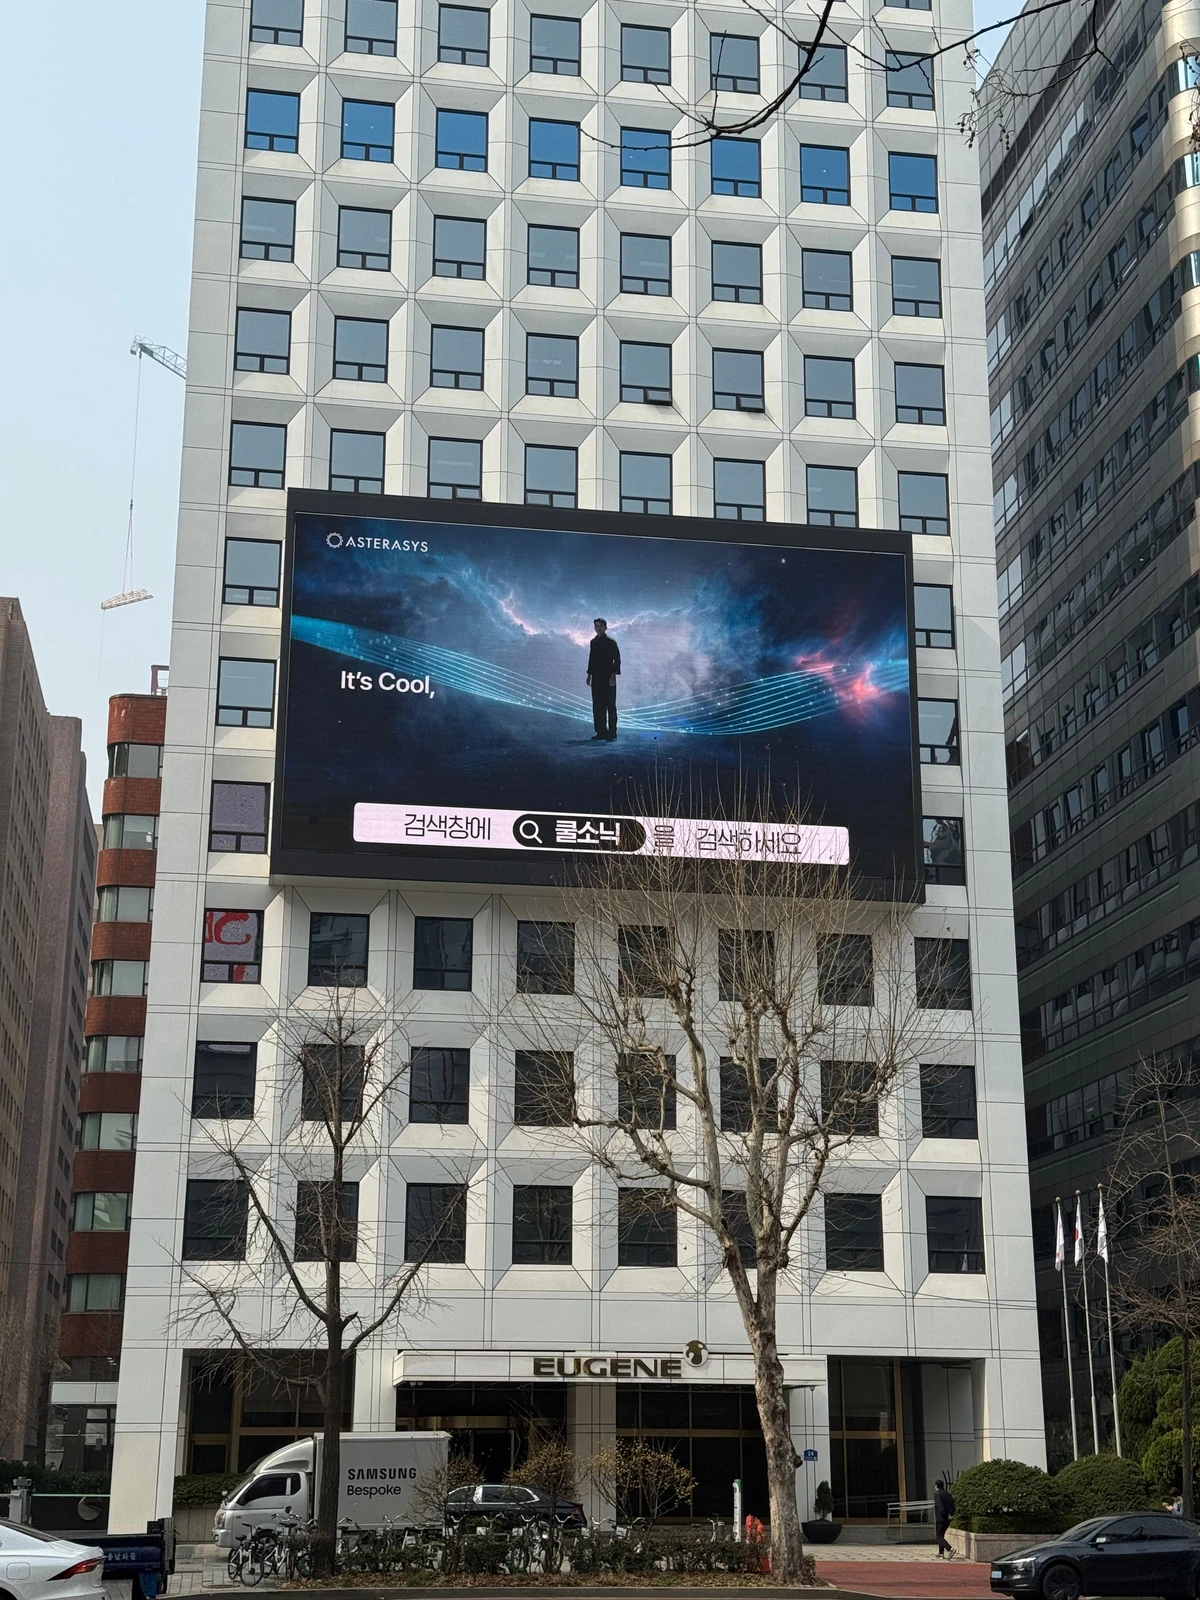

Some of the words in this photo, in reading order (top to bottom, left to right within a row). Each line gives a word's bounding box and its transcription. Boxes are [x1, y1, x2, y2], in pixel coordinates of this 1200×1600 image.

[345, 535, 428, 553] ASTERASYS
[340, 670, 373, 691] It's
[378, 671, 435, 699] Cool,
[403, 813, 492, 841] 검색창에
[555, 819, 621, 846] 쿨소닉
[697, 827, 802, 855] 검색하세요
[533, 1357, 682, 1378] EUGENE
[347, 1467, 417, 1481] SAMSUNG
[347, 1484, 401, 1499] Bespoke
